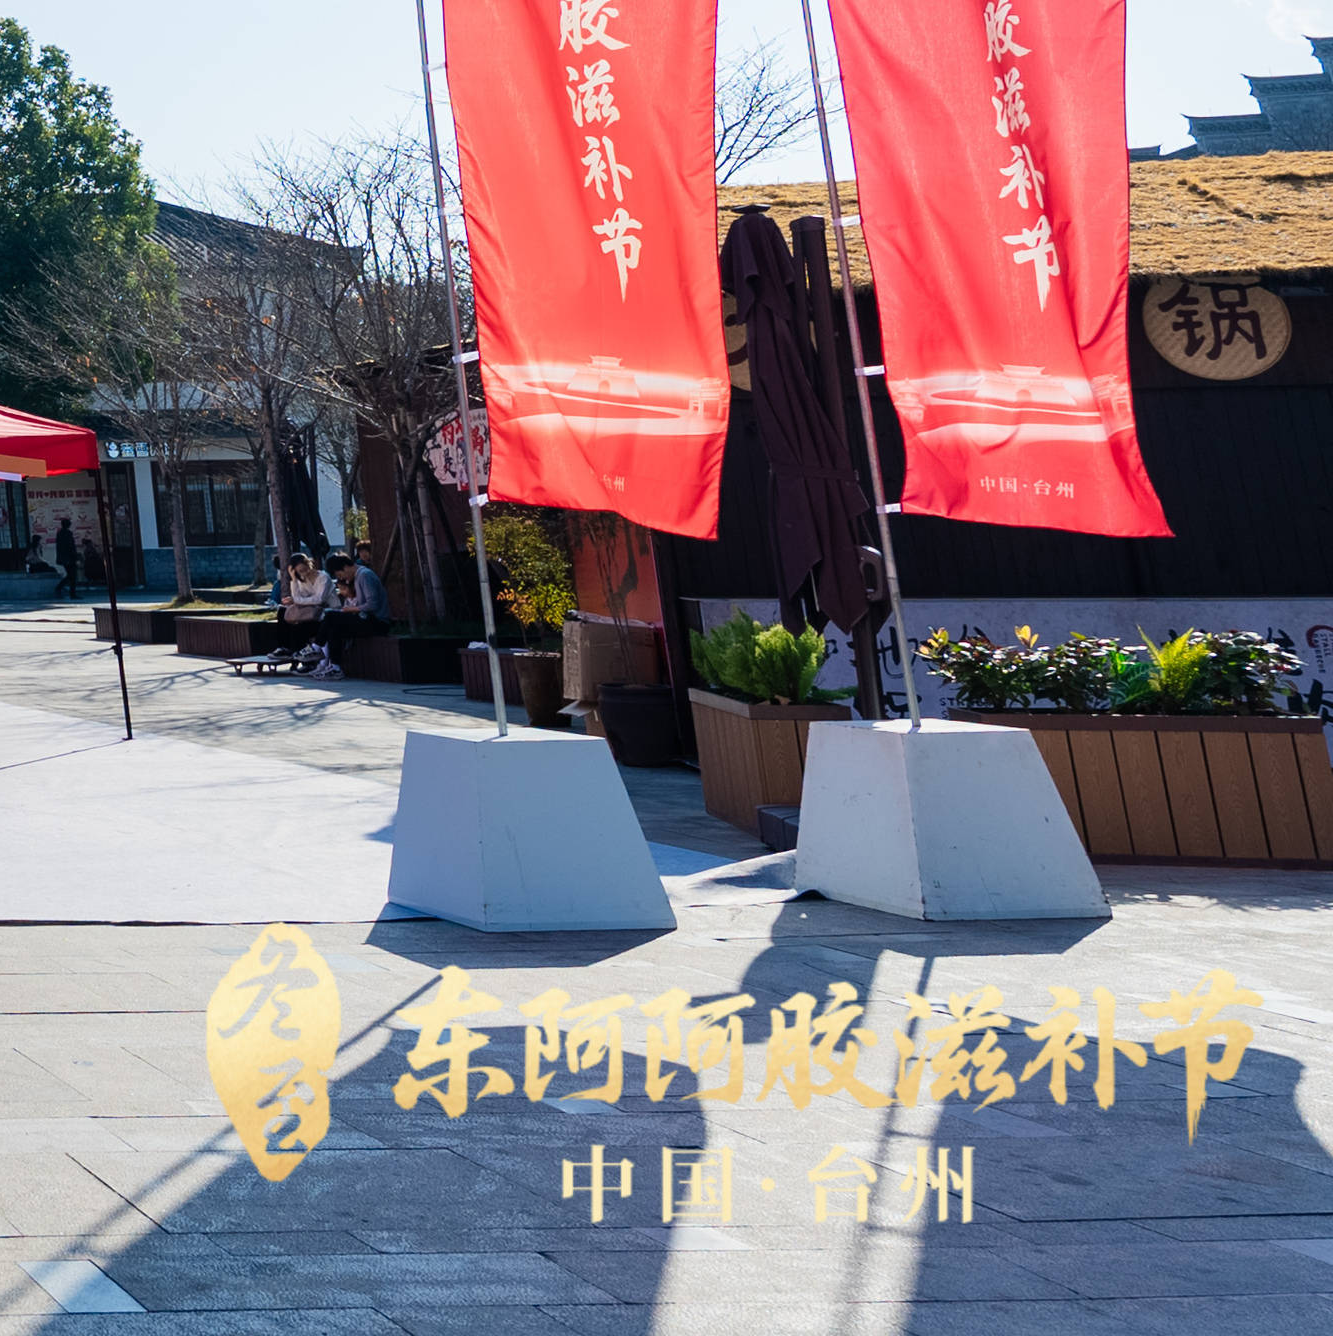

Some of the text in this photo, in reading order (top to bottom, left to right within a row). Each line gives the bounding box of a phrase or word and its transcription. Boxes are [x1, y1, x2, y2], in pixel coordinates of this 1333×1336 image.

[1158, 281, 1267, 360] 锅
[980, 475, 1075, 499] 中国·台州
